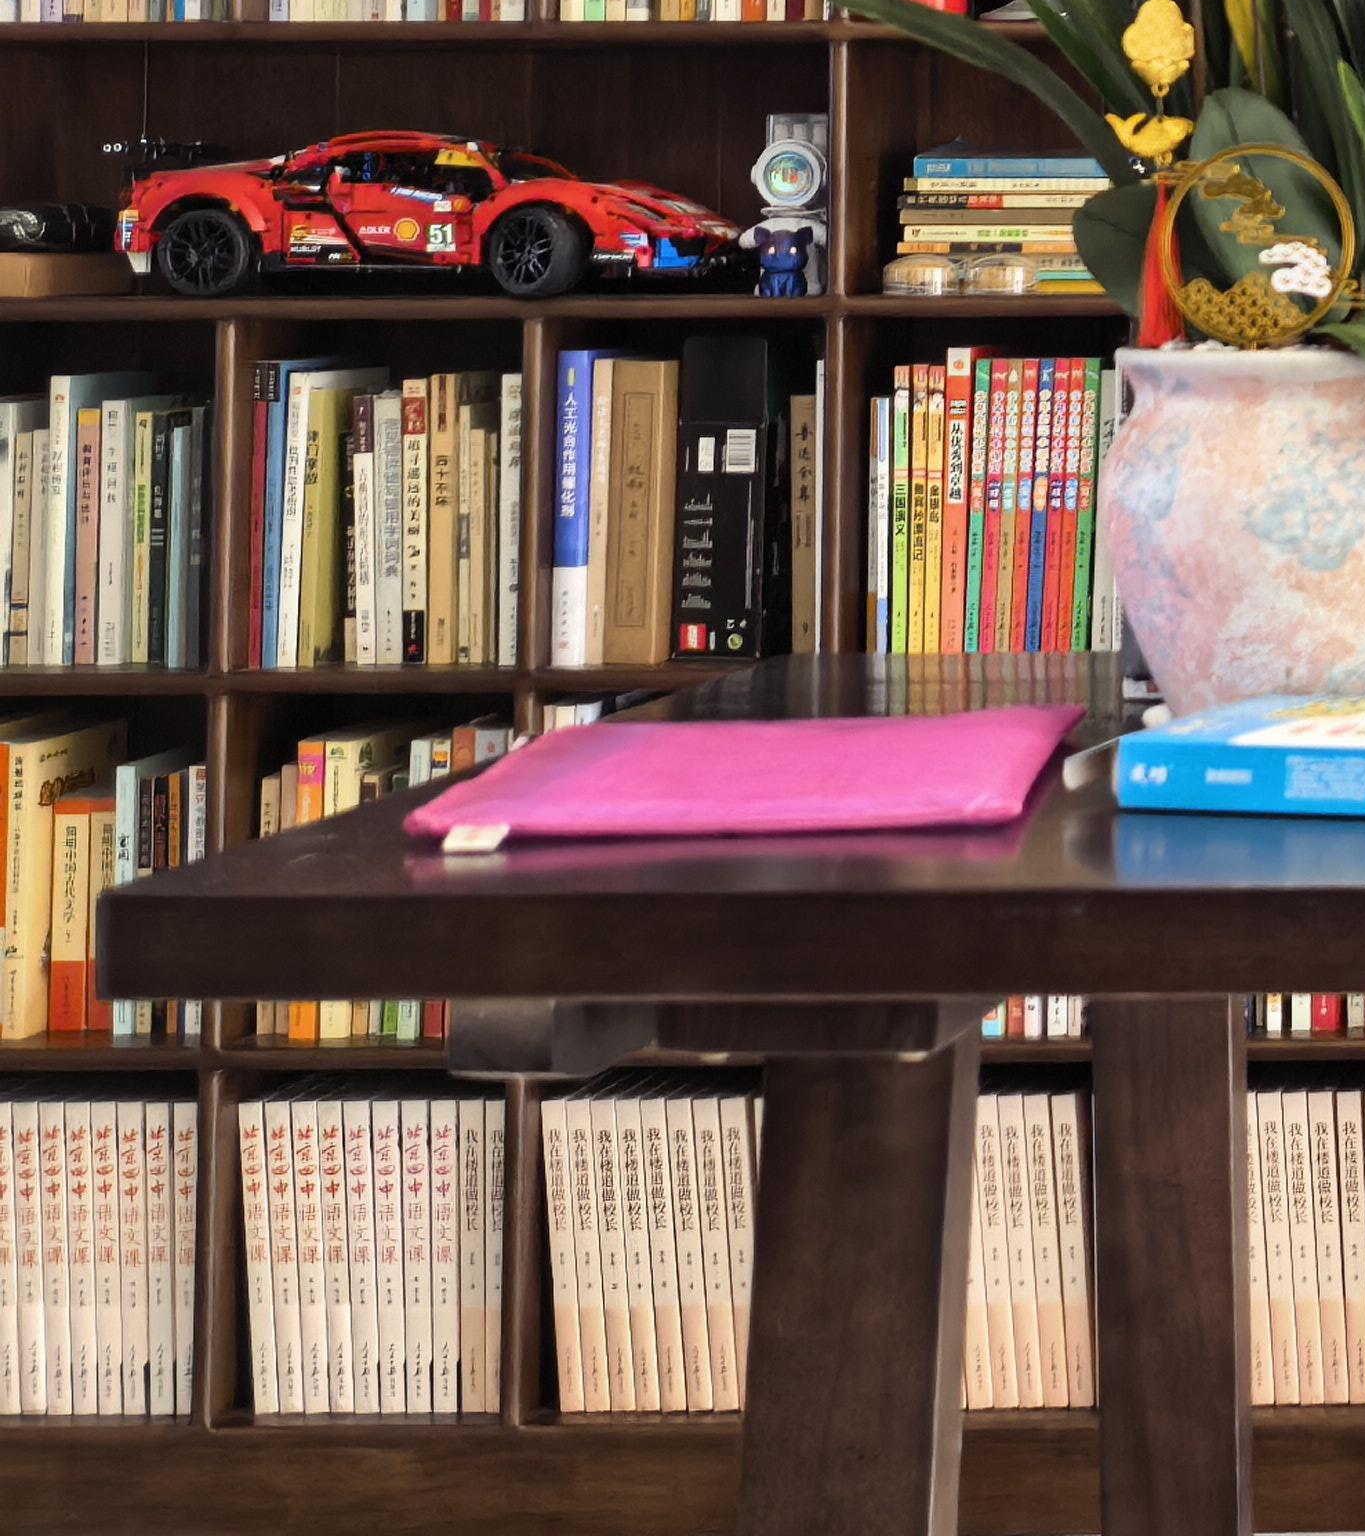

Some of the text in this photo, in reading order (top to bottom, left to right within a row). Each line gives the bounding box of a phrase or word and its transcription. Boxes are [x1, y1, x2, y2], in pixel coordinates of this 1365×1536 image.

[428, 224, 452, 245] 51
[548, 1128, 569, 1233] 我在楼道做校长
[622, 1128, 644, 1232] 我在楼道做校长
[980, 1123, 1001, 1229] 我在楼道做校长
[1032, 1122, 1052, 1227] 我在楼道做校长
[1263, 1120, 1284, 1225] 我在楼道做校长
